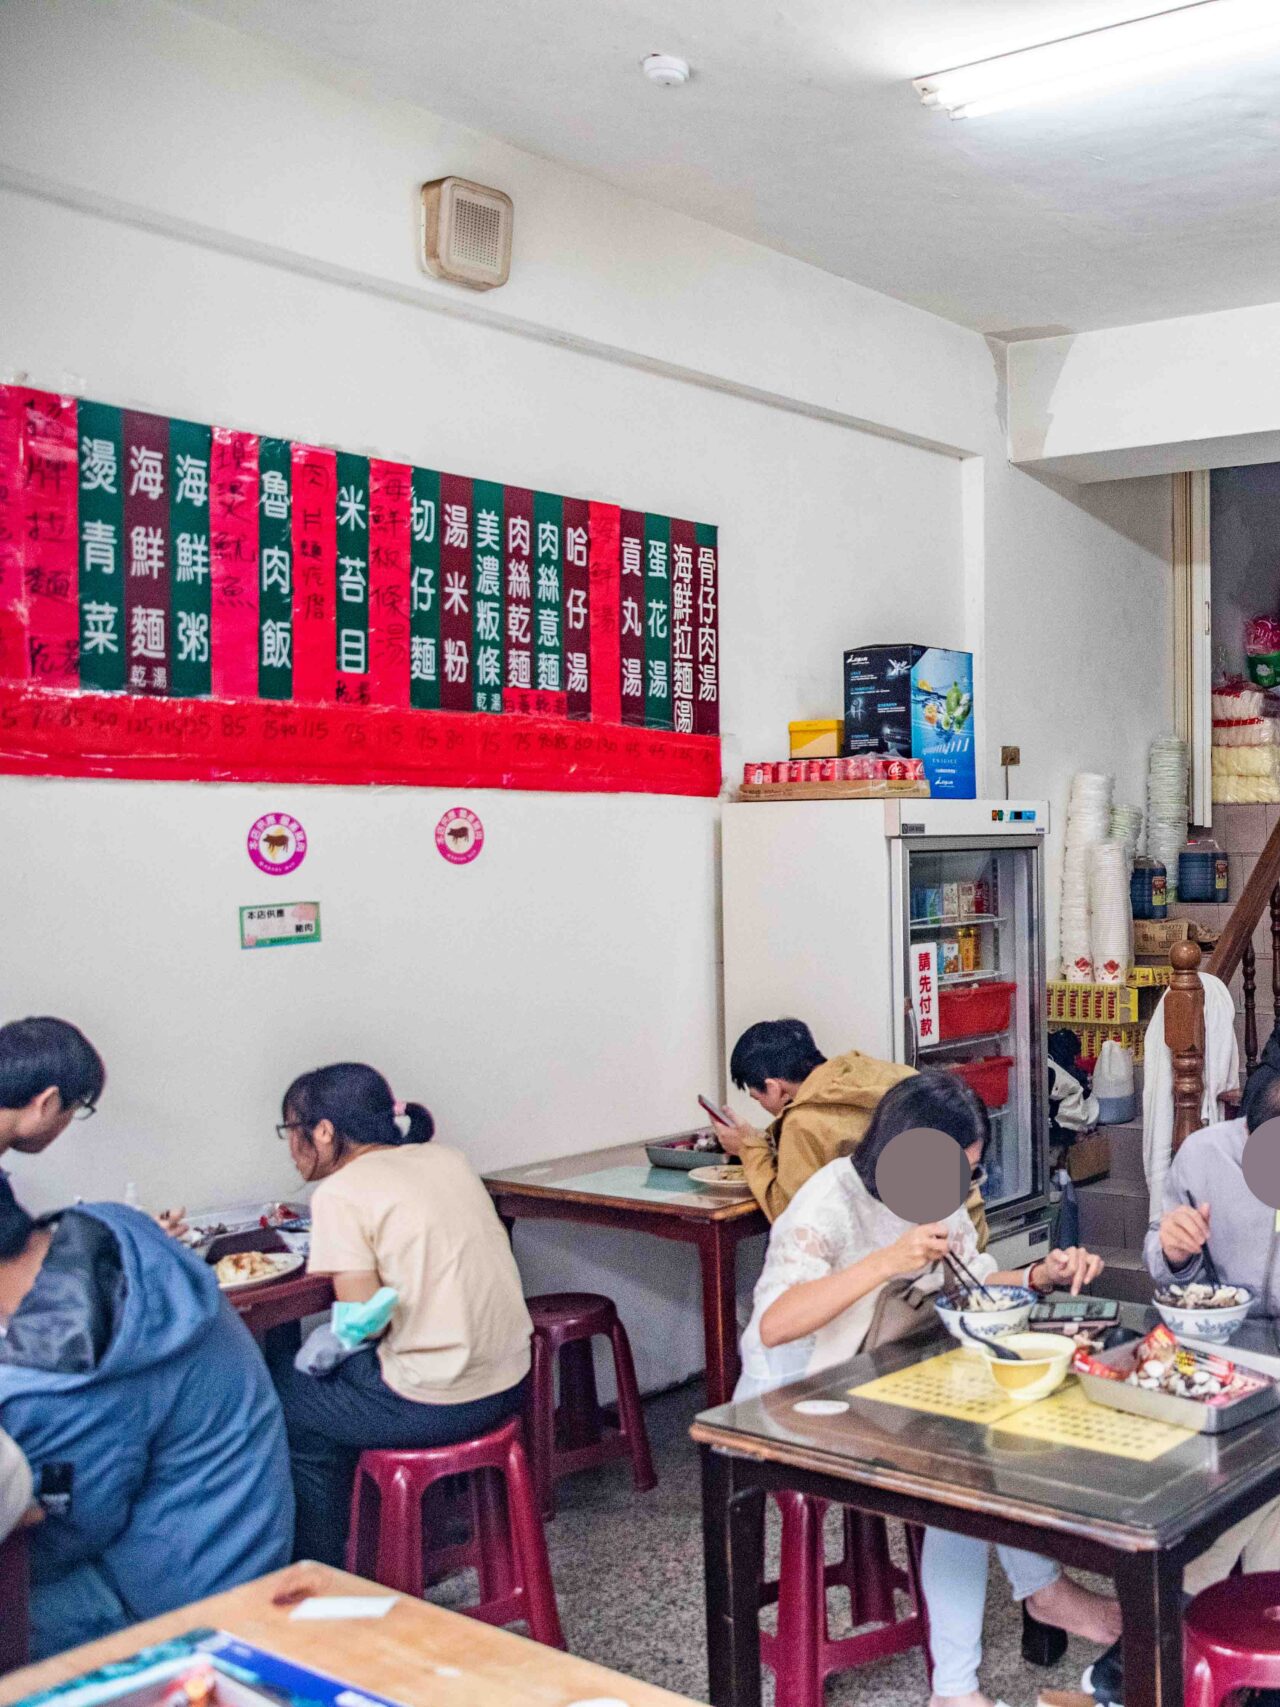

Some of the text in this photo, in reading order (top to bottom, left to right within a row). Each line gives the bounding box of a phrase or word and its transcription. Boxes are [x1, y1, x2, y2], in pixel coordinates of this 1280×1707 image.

[82, 436, 119, 656] 燙青菜
[130, 445, 166, 660] 海鮮麵
[176, 454, 210, 663] 海鮮粥
[261, 470, 292, 670] 魯肉飯
[337, 484, 367, 674] 米苔目
[410, 499, 436, 682] 切仔麵
[444, 502, 469, 684] 湯米粉
[476, 508, 501, 686] 美濃粄條
[508, 514, 531, 690] 肉絲乾麵
[537, 520, 560, 692] 肉絲意麵
[620, 536, 642, 698] 貢丸湯
[647, 539, 668, 699] 蛋花湯
[697, 546, 717, 702] 骨仔肉湯
[918, 951, 932, 1037] 請先付款
